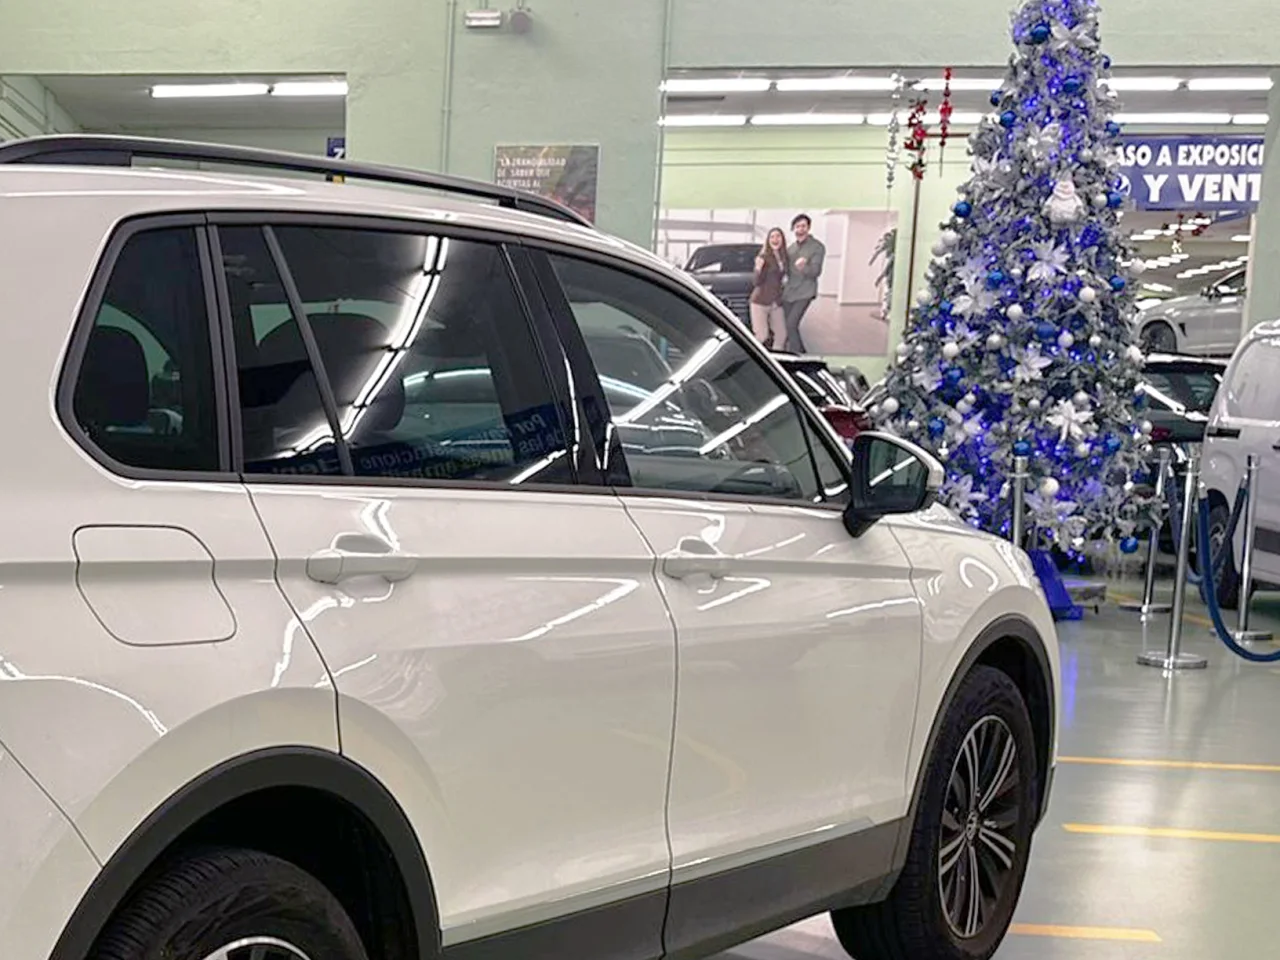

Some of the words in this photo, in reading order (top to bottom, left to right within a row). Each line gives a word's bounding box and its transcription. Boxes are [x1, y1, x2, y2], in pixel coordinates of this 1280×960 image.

[1116, 144, 1152, 167] ASO
[1156, 145, 1172, 166] A
[1177, 144, 1264, 166] EXPOSICI
[1143, 173, 1169, 202] Y
[1178, 173, 1262, 202] VENT
